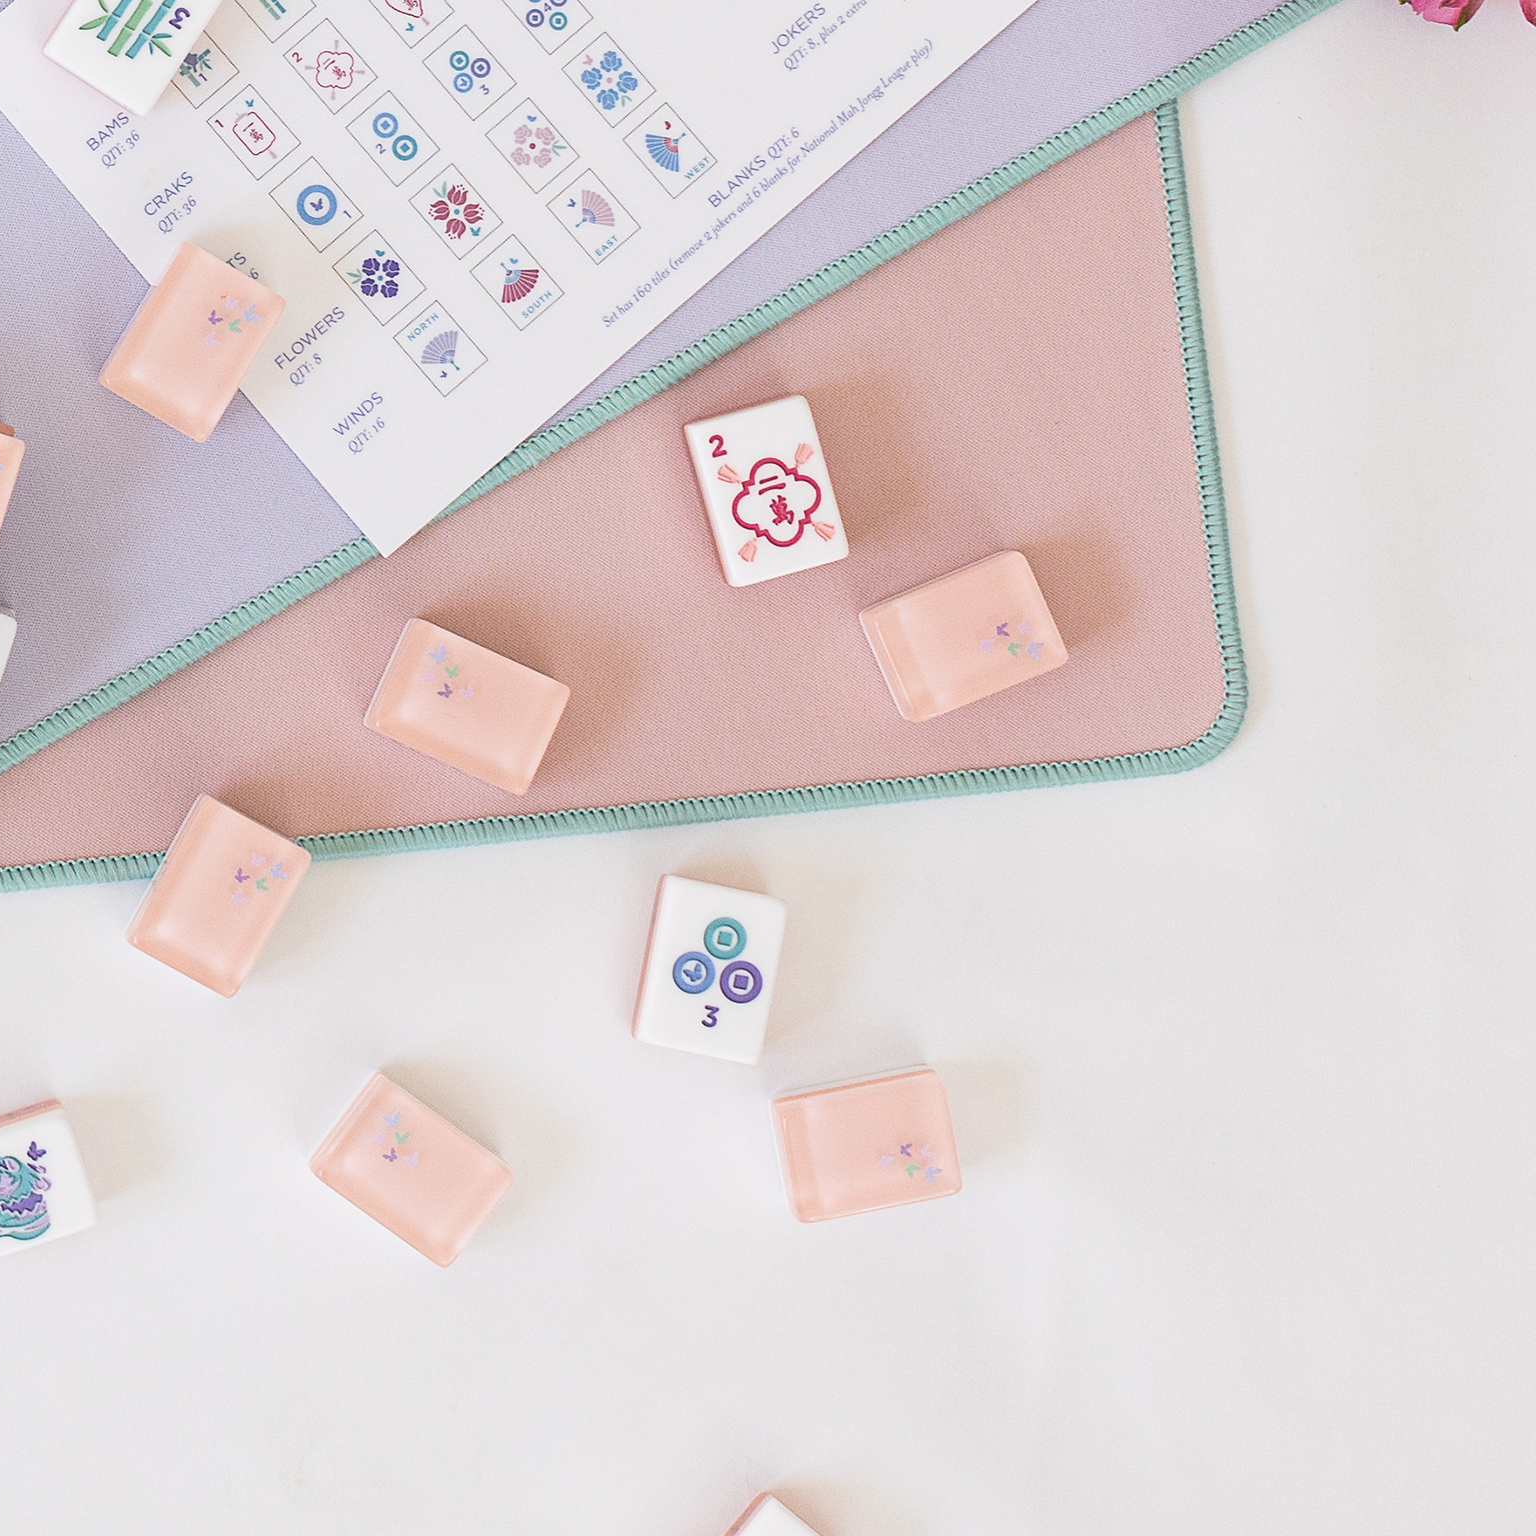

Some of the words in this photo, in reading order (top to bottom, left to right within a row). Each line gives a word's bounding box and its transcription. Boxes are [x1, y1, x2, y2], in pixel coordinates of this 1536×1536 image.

[166, 5, 191, 30] 3
[543, 2, 553, 13] 4
[771, 2, 826, 55] JOKERS
[291, 51, 303, 63] 2
[783, 49, 805, 72] QTY:
[818, 22, 838, 45] plus
[836, 15, 846, 25] 2
[198, 72, 208, 82] 1
[479, 84, 490, 96] 3
[85, 111, 130, 152] BAMS
[214, 119, 224, 128] 1
[101, 142, 123, 169] QTY:
[125, 129, 140, 148] 36
[375, 143, 387, 155] 2
[683, 156, 710, 180] WEST
[707, 155, 767, 208] BLANKS
[767, 134, 789, 161] QTY:
[790, 126, 800, 139] 6
[143, 171, 193, 216] CRAKS
[602, 311, 619, 328] Set
[615, 301, 634, 316] has
[632, 282, 652, 303] 160
[650, 268, 671, 286] tiles
[668, 239, 705, 271] (remove
[703, 231, 713, 242] 2
[711, 210, 737, 240] jokers
[736, 192, 755, 214] and
[752, 189, 762, 199] 6
[758, 167, 789, 192] blanks
[786, 154, 801, 174] for
[799, 119, 839, 158] National
[836, 104, 860, 126] Mah
[856, 85, 885, 113] Jongg
[879, 60, 912, 89] League
[910, 38, 933, 68] play)
[158, 211, 183, 235] QTY:
[182, 194, 197, 216] 36
[342, 210, 352, 219] 1
[594, 234, 618, 257] EAST
[521, 290, 553, 319] SOUTH
[274, 306, 345, 370] FLOWERS
[406, 312, 439, 342] NORTH
[289, 363, 311, 387] QTY:
[312, 352, 322, 365] 8
[332, 391, 384, 436] WINDS
[348, 428, 370, 455] QTY:
[371, 416, 385, 433] 16
[708, 434, 728, 459] 2
[701, 1004, 720, 1028] 3
